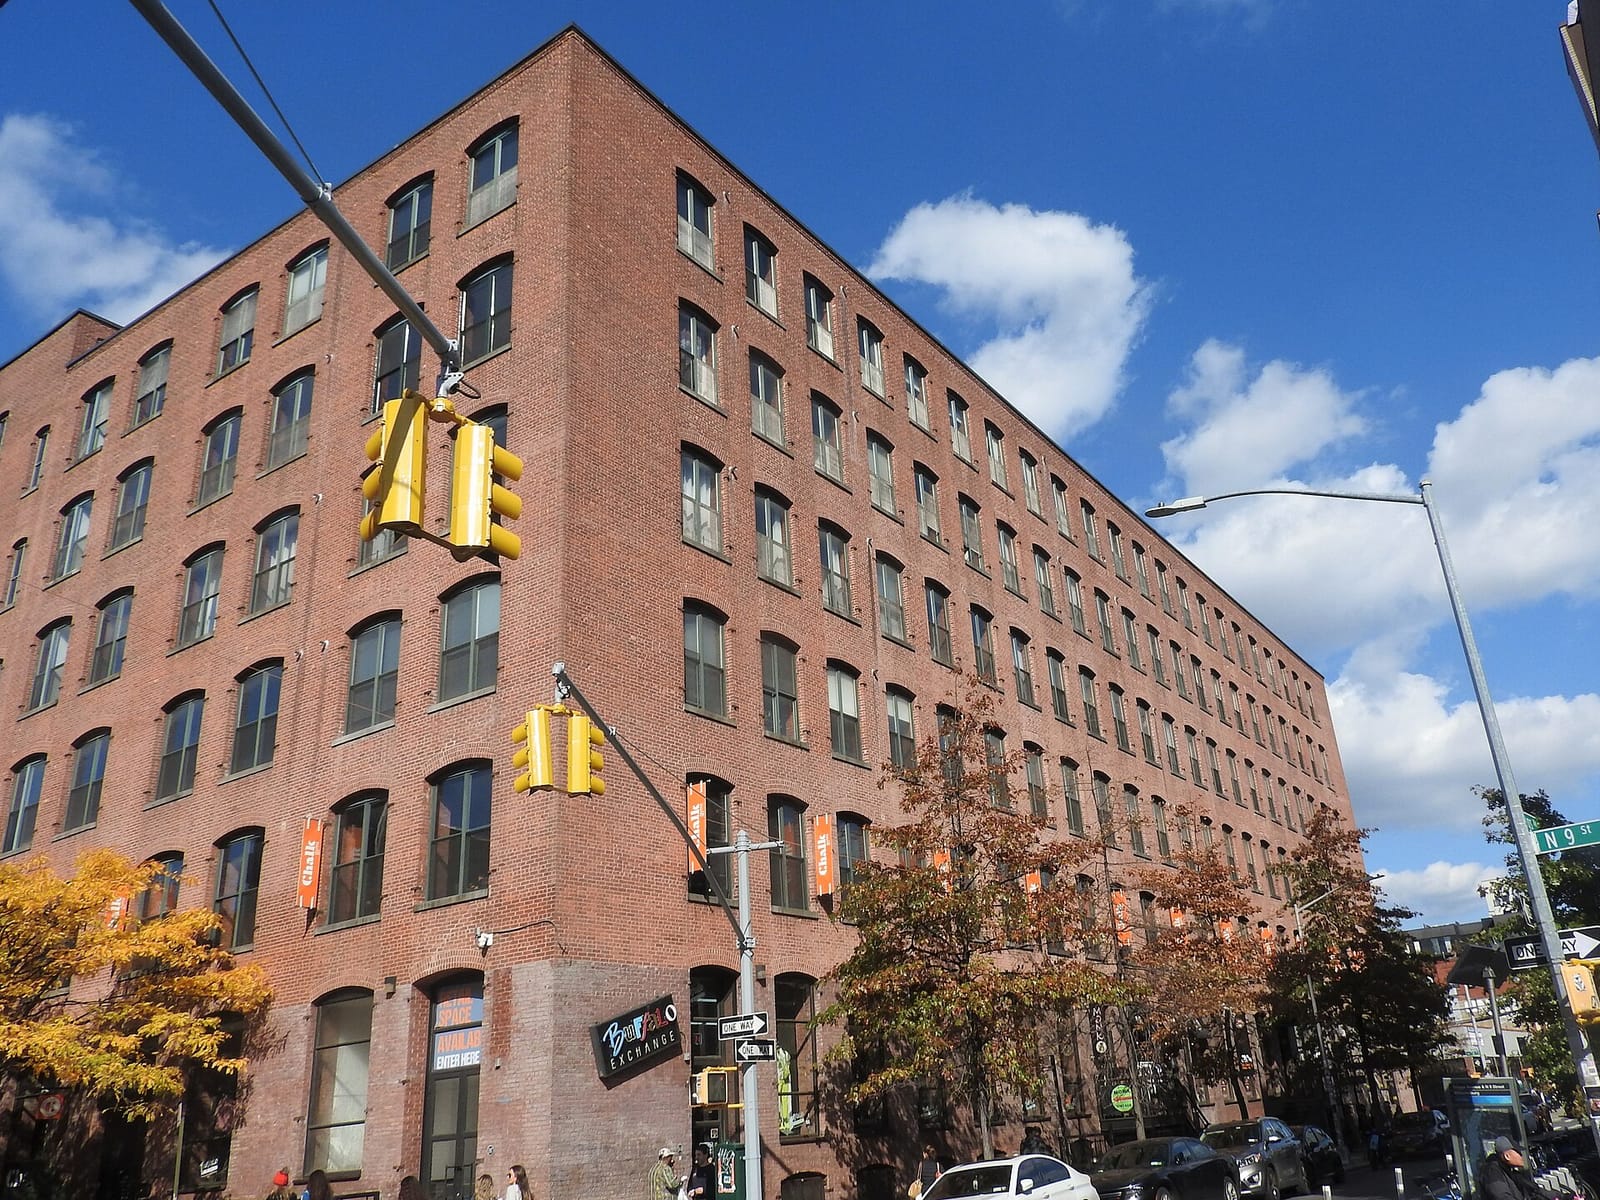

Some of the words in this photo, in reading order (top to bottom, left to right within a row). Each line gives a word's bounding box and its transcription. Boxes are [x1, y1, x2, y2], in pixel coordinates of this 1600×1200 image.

[1544, 831, 1559, 849] N
[1564, 828, 1575, 846] 9
[1580, 824, 1593, 835] St
[302, 840, 316, 887] Chalk
[817, 834, 827, 876] Chalk
[1516, 943, 1544, 958] ONE
[1561, 939, 1577, 952] AY
[439, 1006, 472, 1027] SPACE
[723, 1022, 737, 1033] ONE
[740, 1020, 754, 1030] WAY
[436, 1053, 460, 1069] ENTER
[461, 1050, 480, 1067] HERE
[610, 1030, 675, 1070] EXCHANGE
[742, 1045, 754, 1055] ONE
